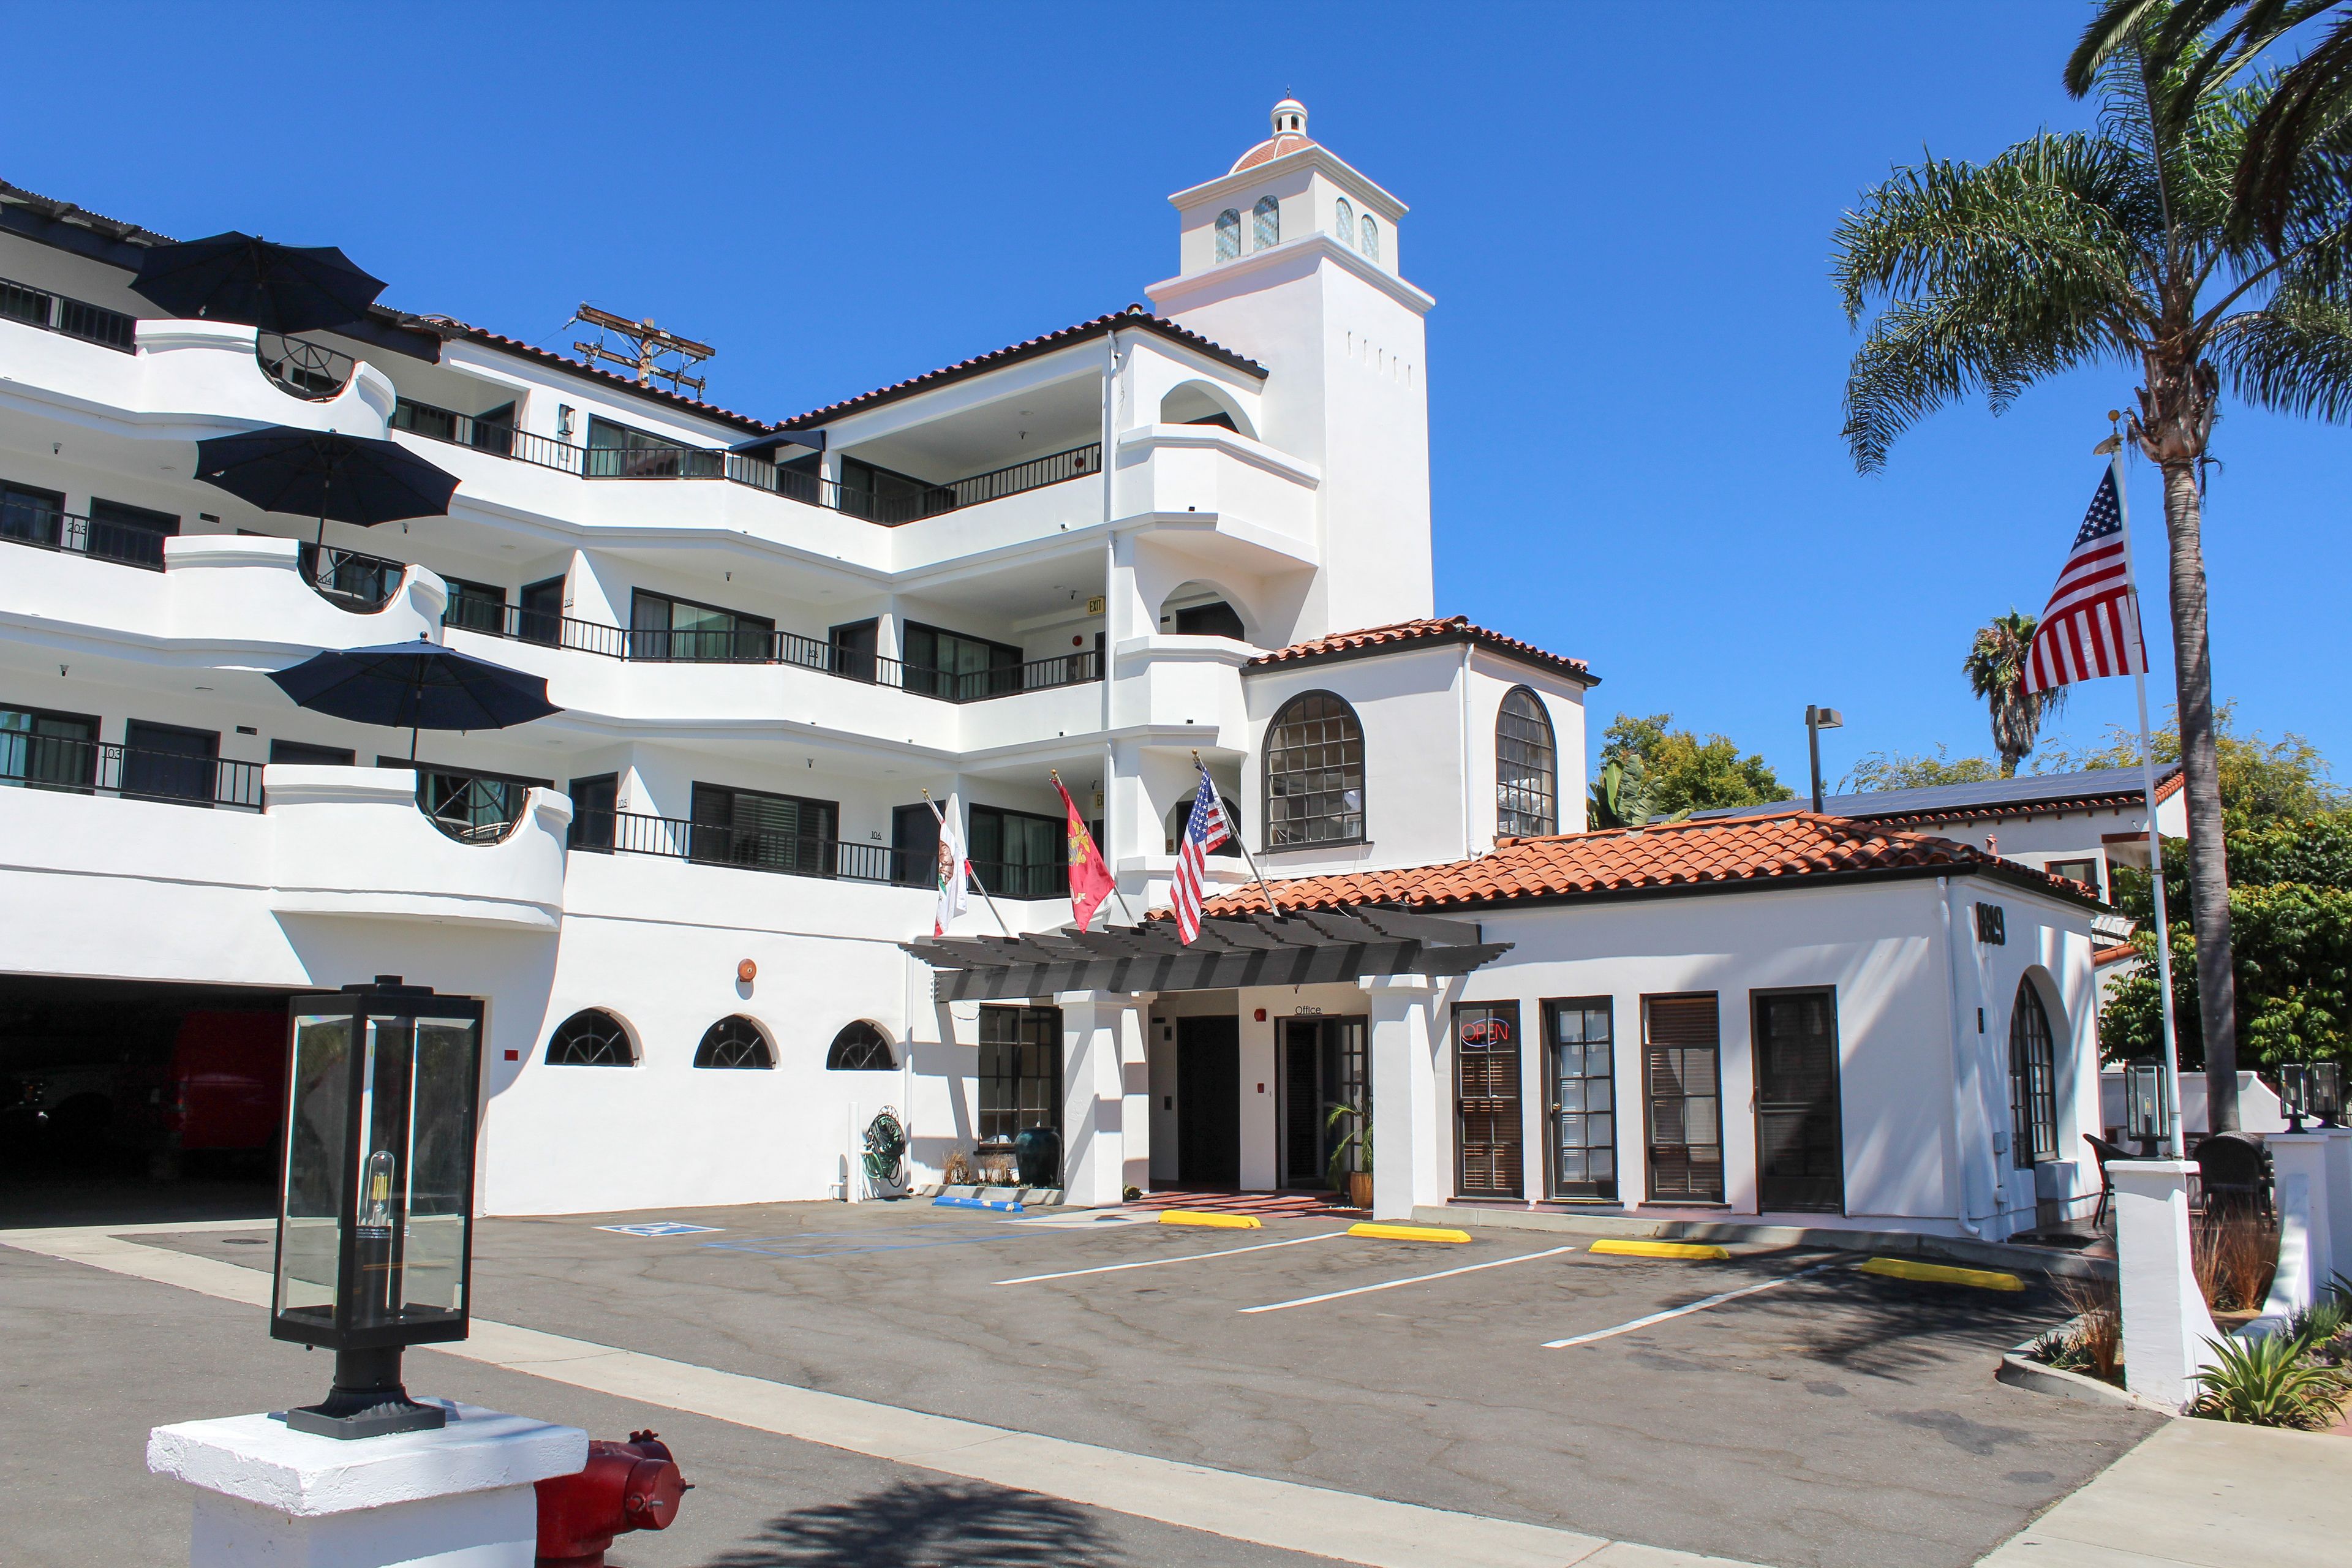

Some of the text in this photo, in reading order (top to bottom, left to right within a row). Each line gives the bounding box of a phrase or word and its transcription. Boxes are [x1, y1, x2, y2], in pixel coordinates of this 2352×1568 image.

[1090, 599, 1101, 612] EXIT
[617, 798, 628, 809] 105
[870, 831, 882, 840] 106
[1976, 902, 2005, 946] 1819
[1294, 1005, 1322, 1016] Office
[1461, 1023, 1508, 1041] OPEN
